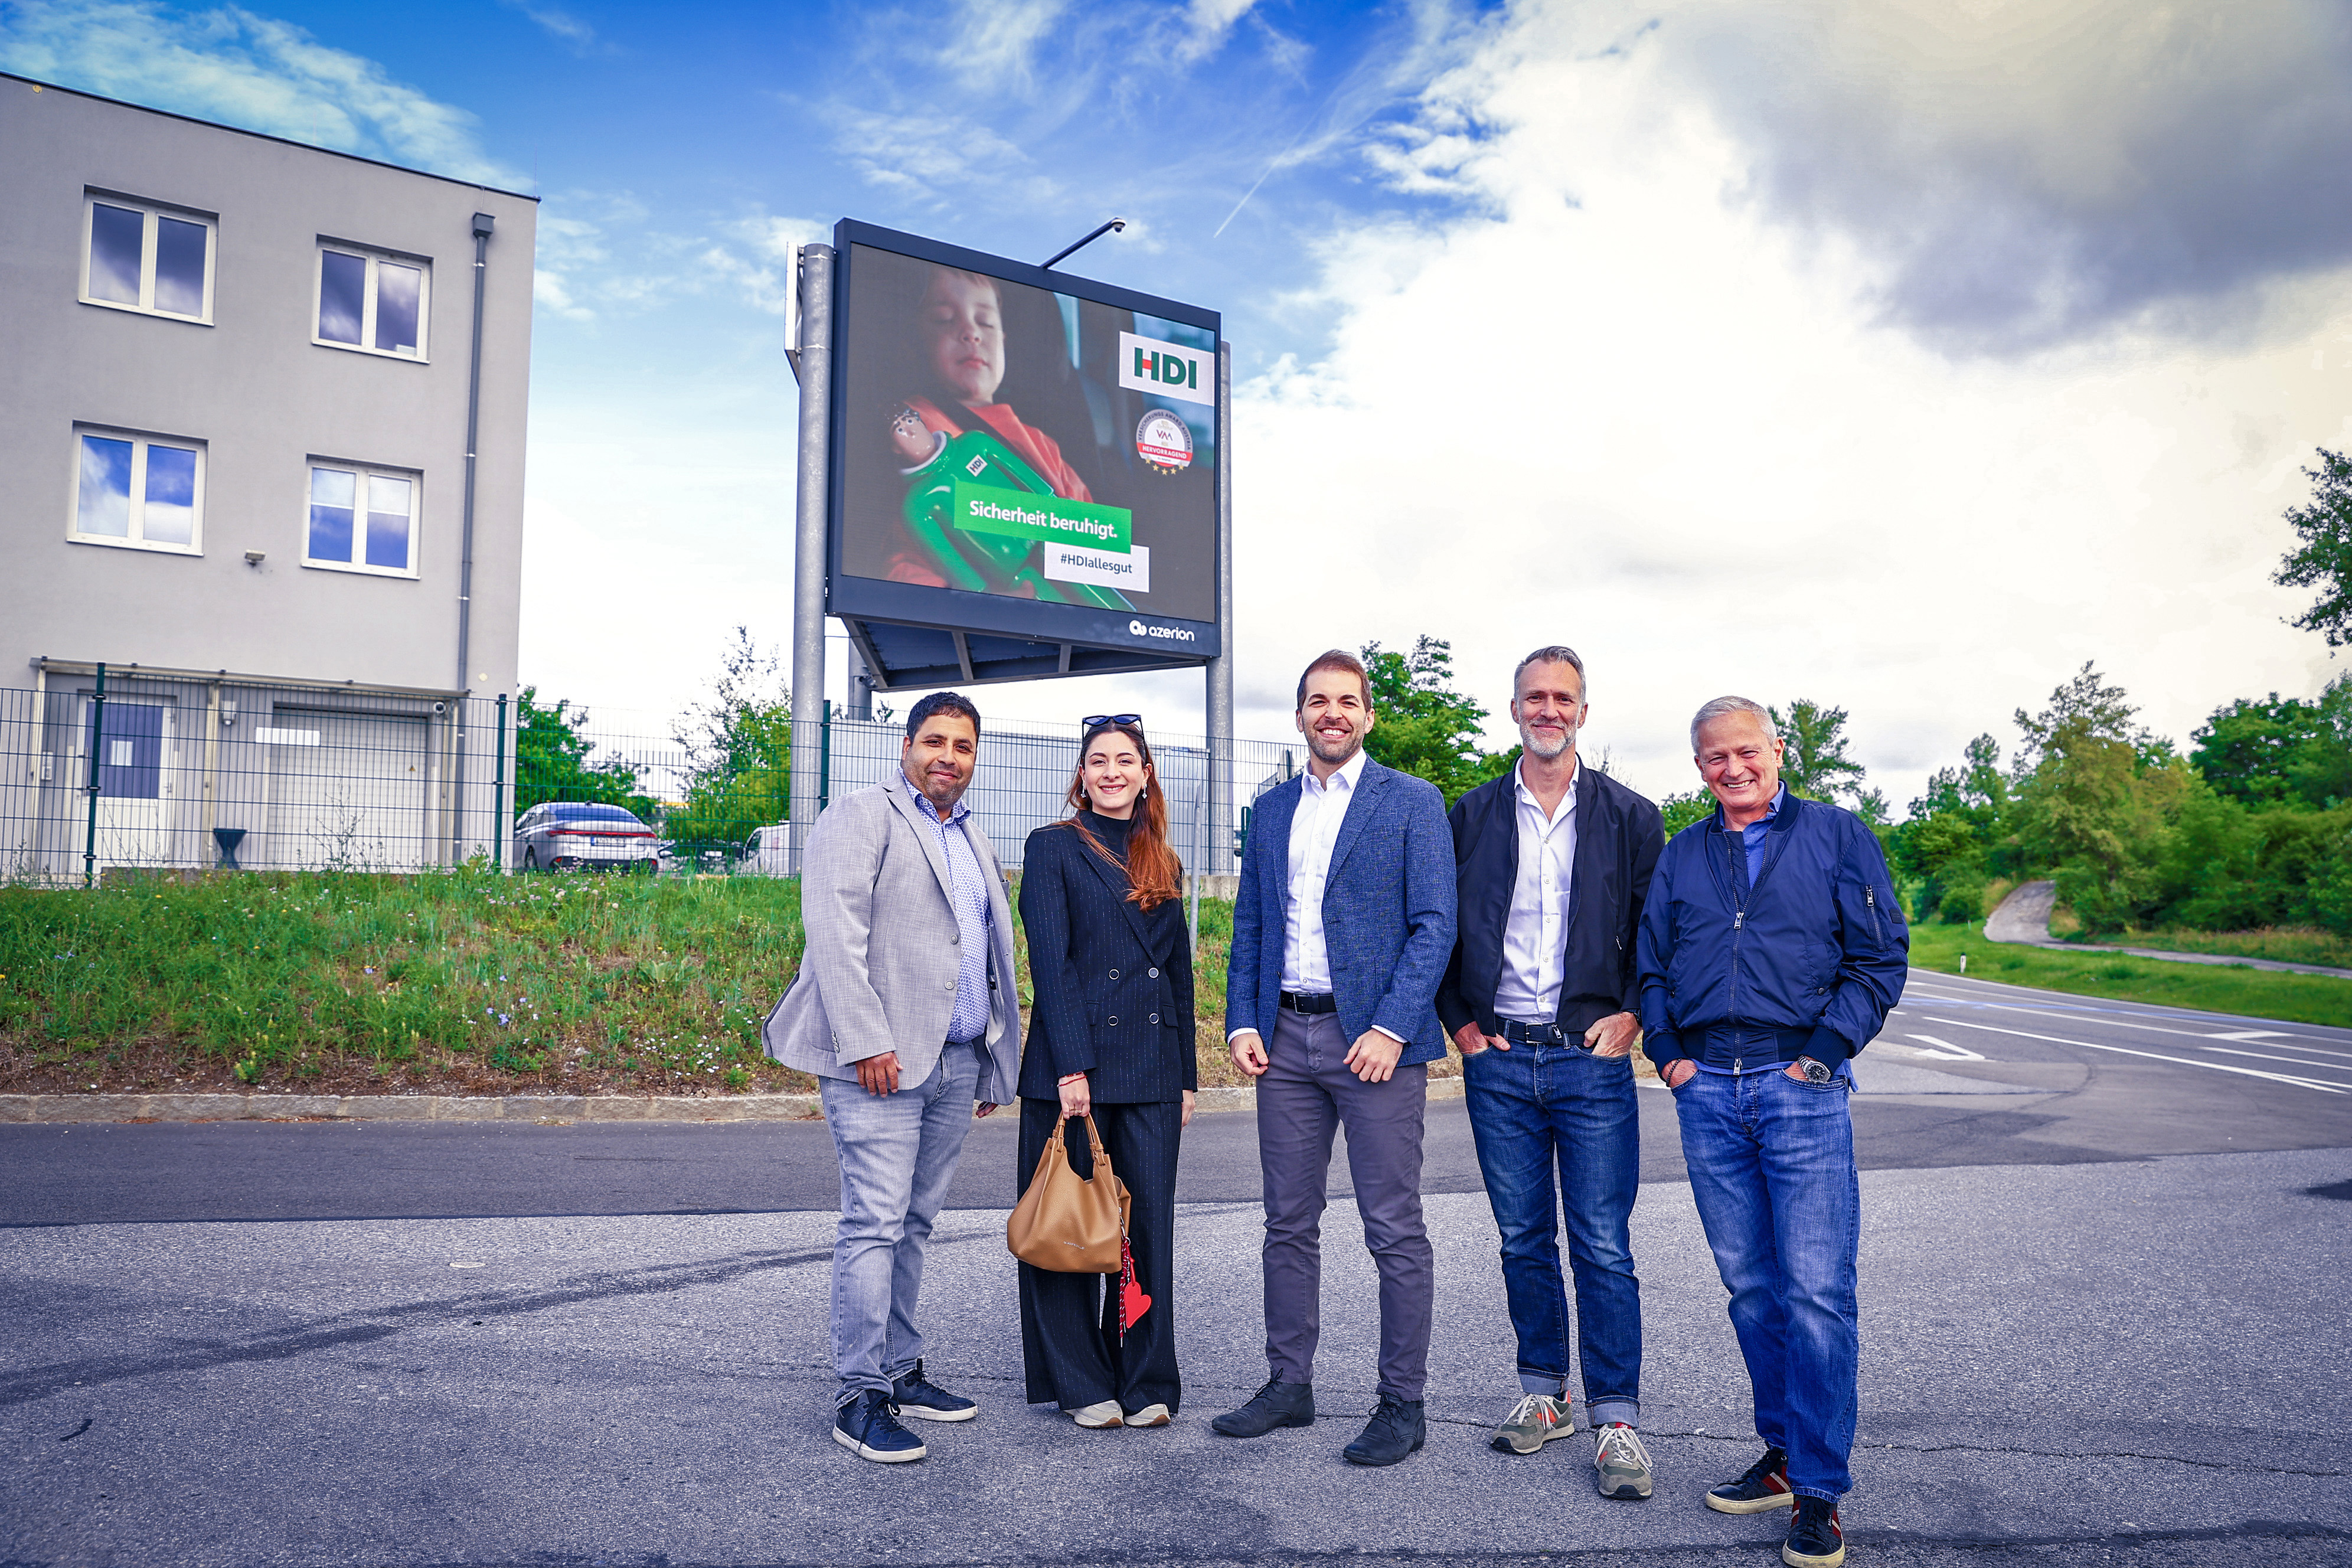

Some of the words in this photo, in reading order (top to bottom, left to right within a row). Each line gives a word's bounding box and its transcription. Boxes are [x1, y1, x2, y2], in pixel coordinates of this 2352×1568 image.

[1135, 347, 1197, 390] HDI
[1165, 412, 1182, 426] AWARD
[1181, 427, 1191, 450] AUSTRIA
[1142, 445, 1187, 459] HERVORRAGEND
[969, 458, 984, 472] HDI
[969, 500, 1047, 527] Sicherheit
[1050, 512, 1118, 540] beruhigt.
[1061, 553, 1132, 574] #HDIallesgut
[1148, 626, 1195, 642] azerion
